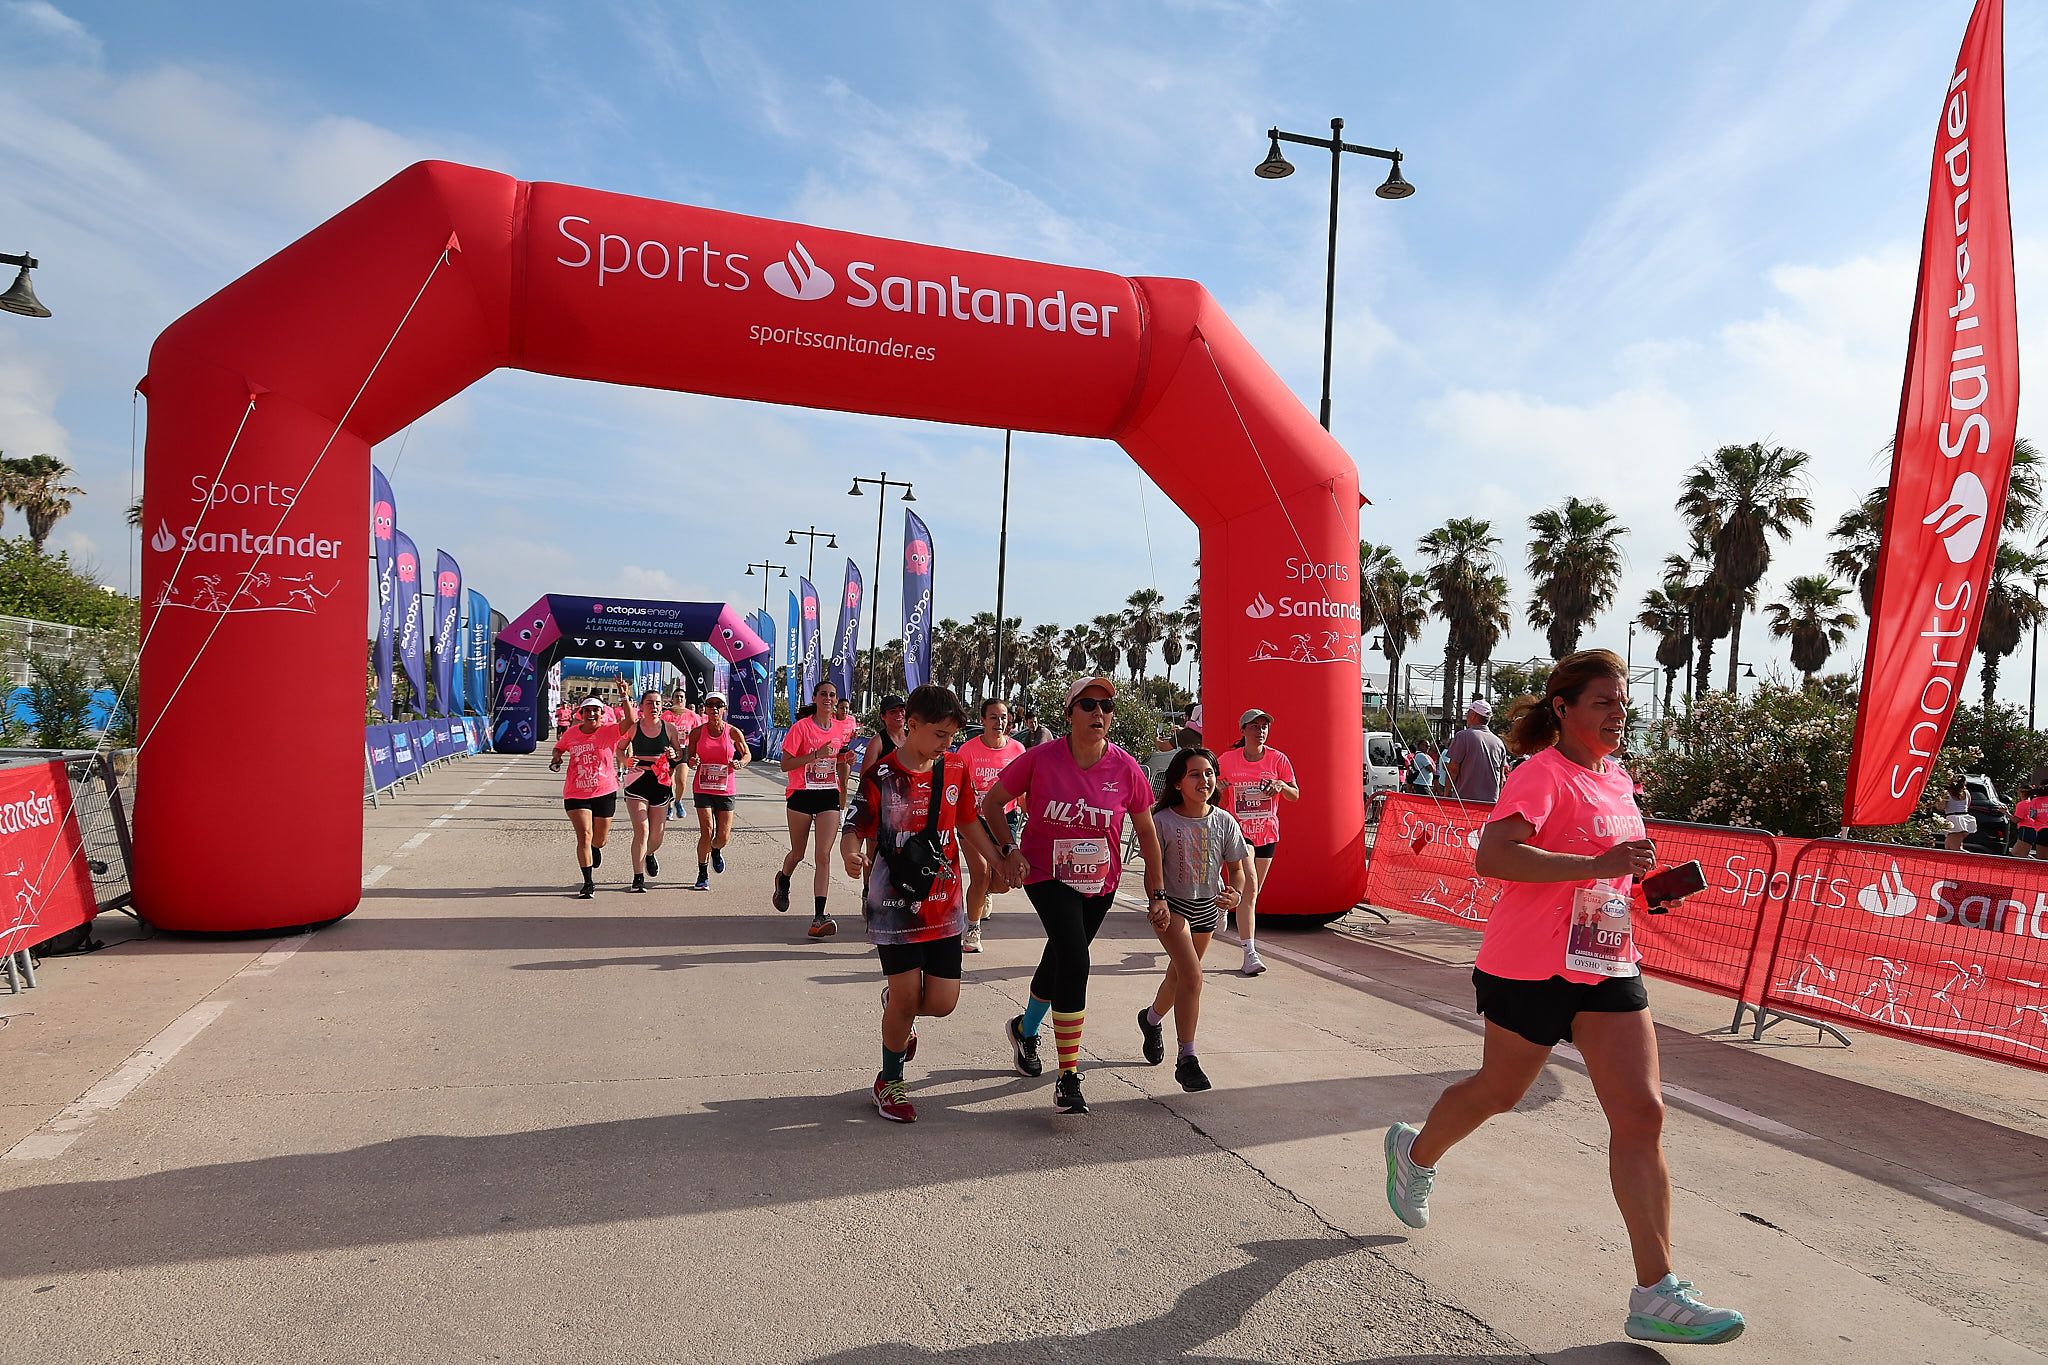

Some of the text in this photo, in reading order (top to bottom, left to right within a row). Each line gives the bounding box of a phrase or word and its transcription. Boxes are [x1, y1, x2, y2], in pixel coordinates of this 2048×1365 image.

[557, 214, 1119, 339] Sports Santander
[749, 324, 936, 363] sportssantander.es
[191, 475, 296, 510] Sports
[180, 525, 342, 559] Santander
[1285, 557, 1349, 584] Sports
[606, 605, 681, 619] octopus energy
[598, 618, 630, 626] ENERGÍA
[631, 620, 652, 628] PARA
[653, 621, 684, 629] CORRER
[604, 626, 646, 634] VELOCIDAD
[573, 637, 664, 651] VOLVO
[1398, 810, 1466, 848] Sports
[1073, 864, 1097, 873] 016
[1719, 855, 1851, 909] Sports
[1597, 930, 1622, 946] 016
[1574, 958, 1600, 969] OYSHO
